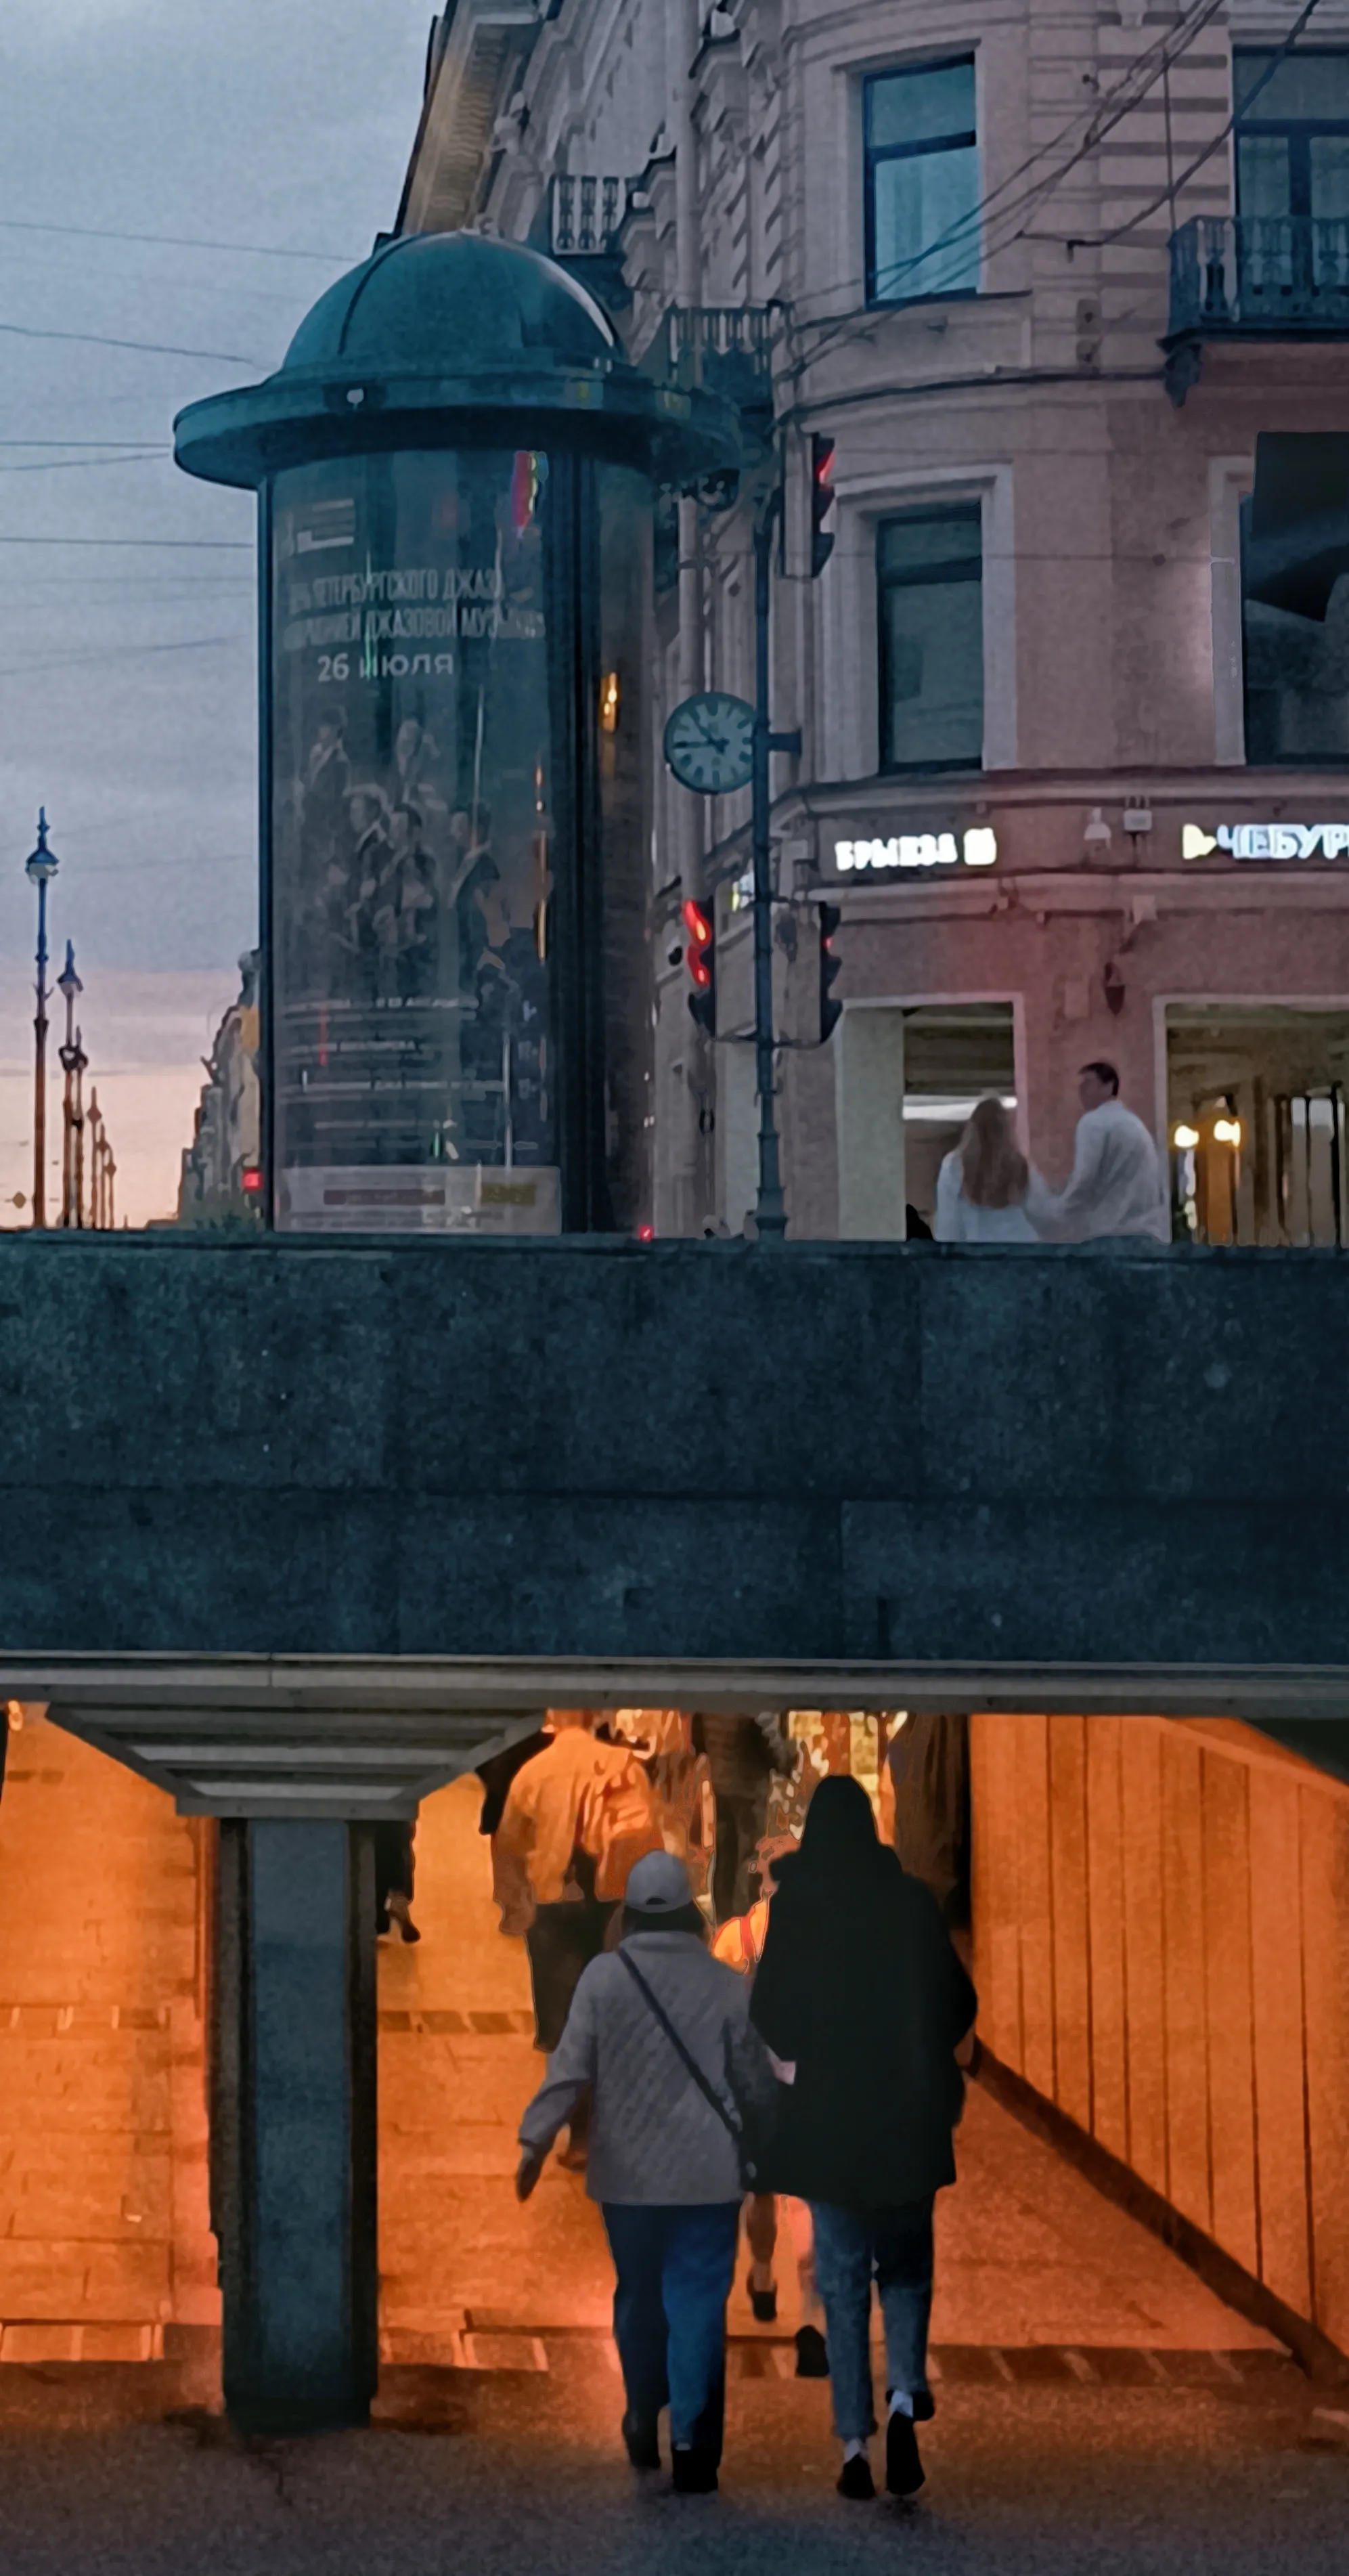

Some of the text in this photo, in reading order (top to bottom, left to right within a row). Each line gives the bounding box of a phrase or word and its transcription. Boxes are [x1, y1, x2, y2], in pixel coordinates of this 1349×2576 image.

[317, 652, 454, 682] 26 июля
[1216, 823, 1349, 860] ЧЕБУР
